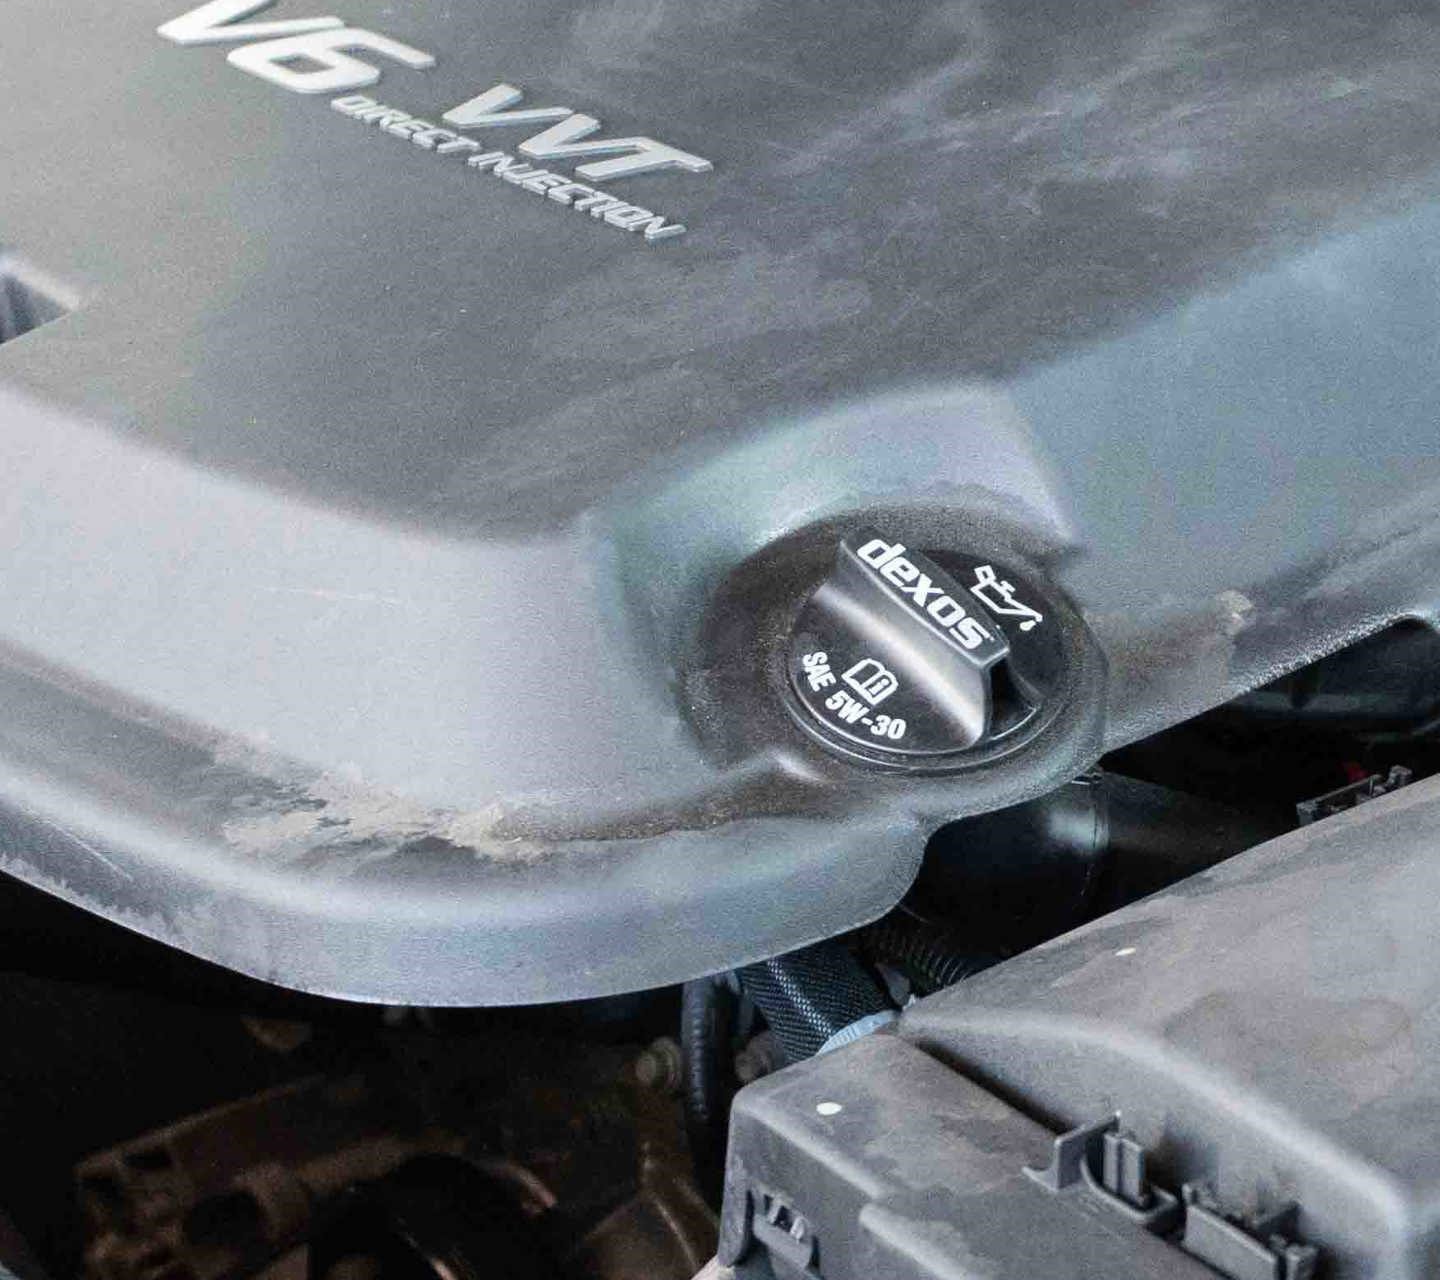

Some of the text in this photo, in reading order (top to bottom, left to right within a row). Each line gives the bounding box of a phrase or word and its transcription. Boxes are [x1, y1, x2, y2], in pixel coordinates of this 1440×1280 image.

[330, 93, 687, 241] DIRECT INJECTION
[442, 82, 714, 183] VVT
[856, 537, 987, 651] dexos
[801, 650, 907, 741] SAE 5W-30
